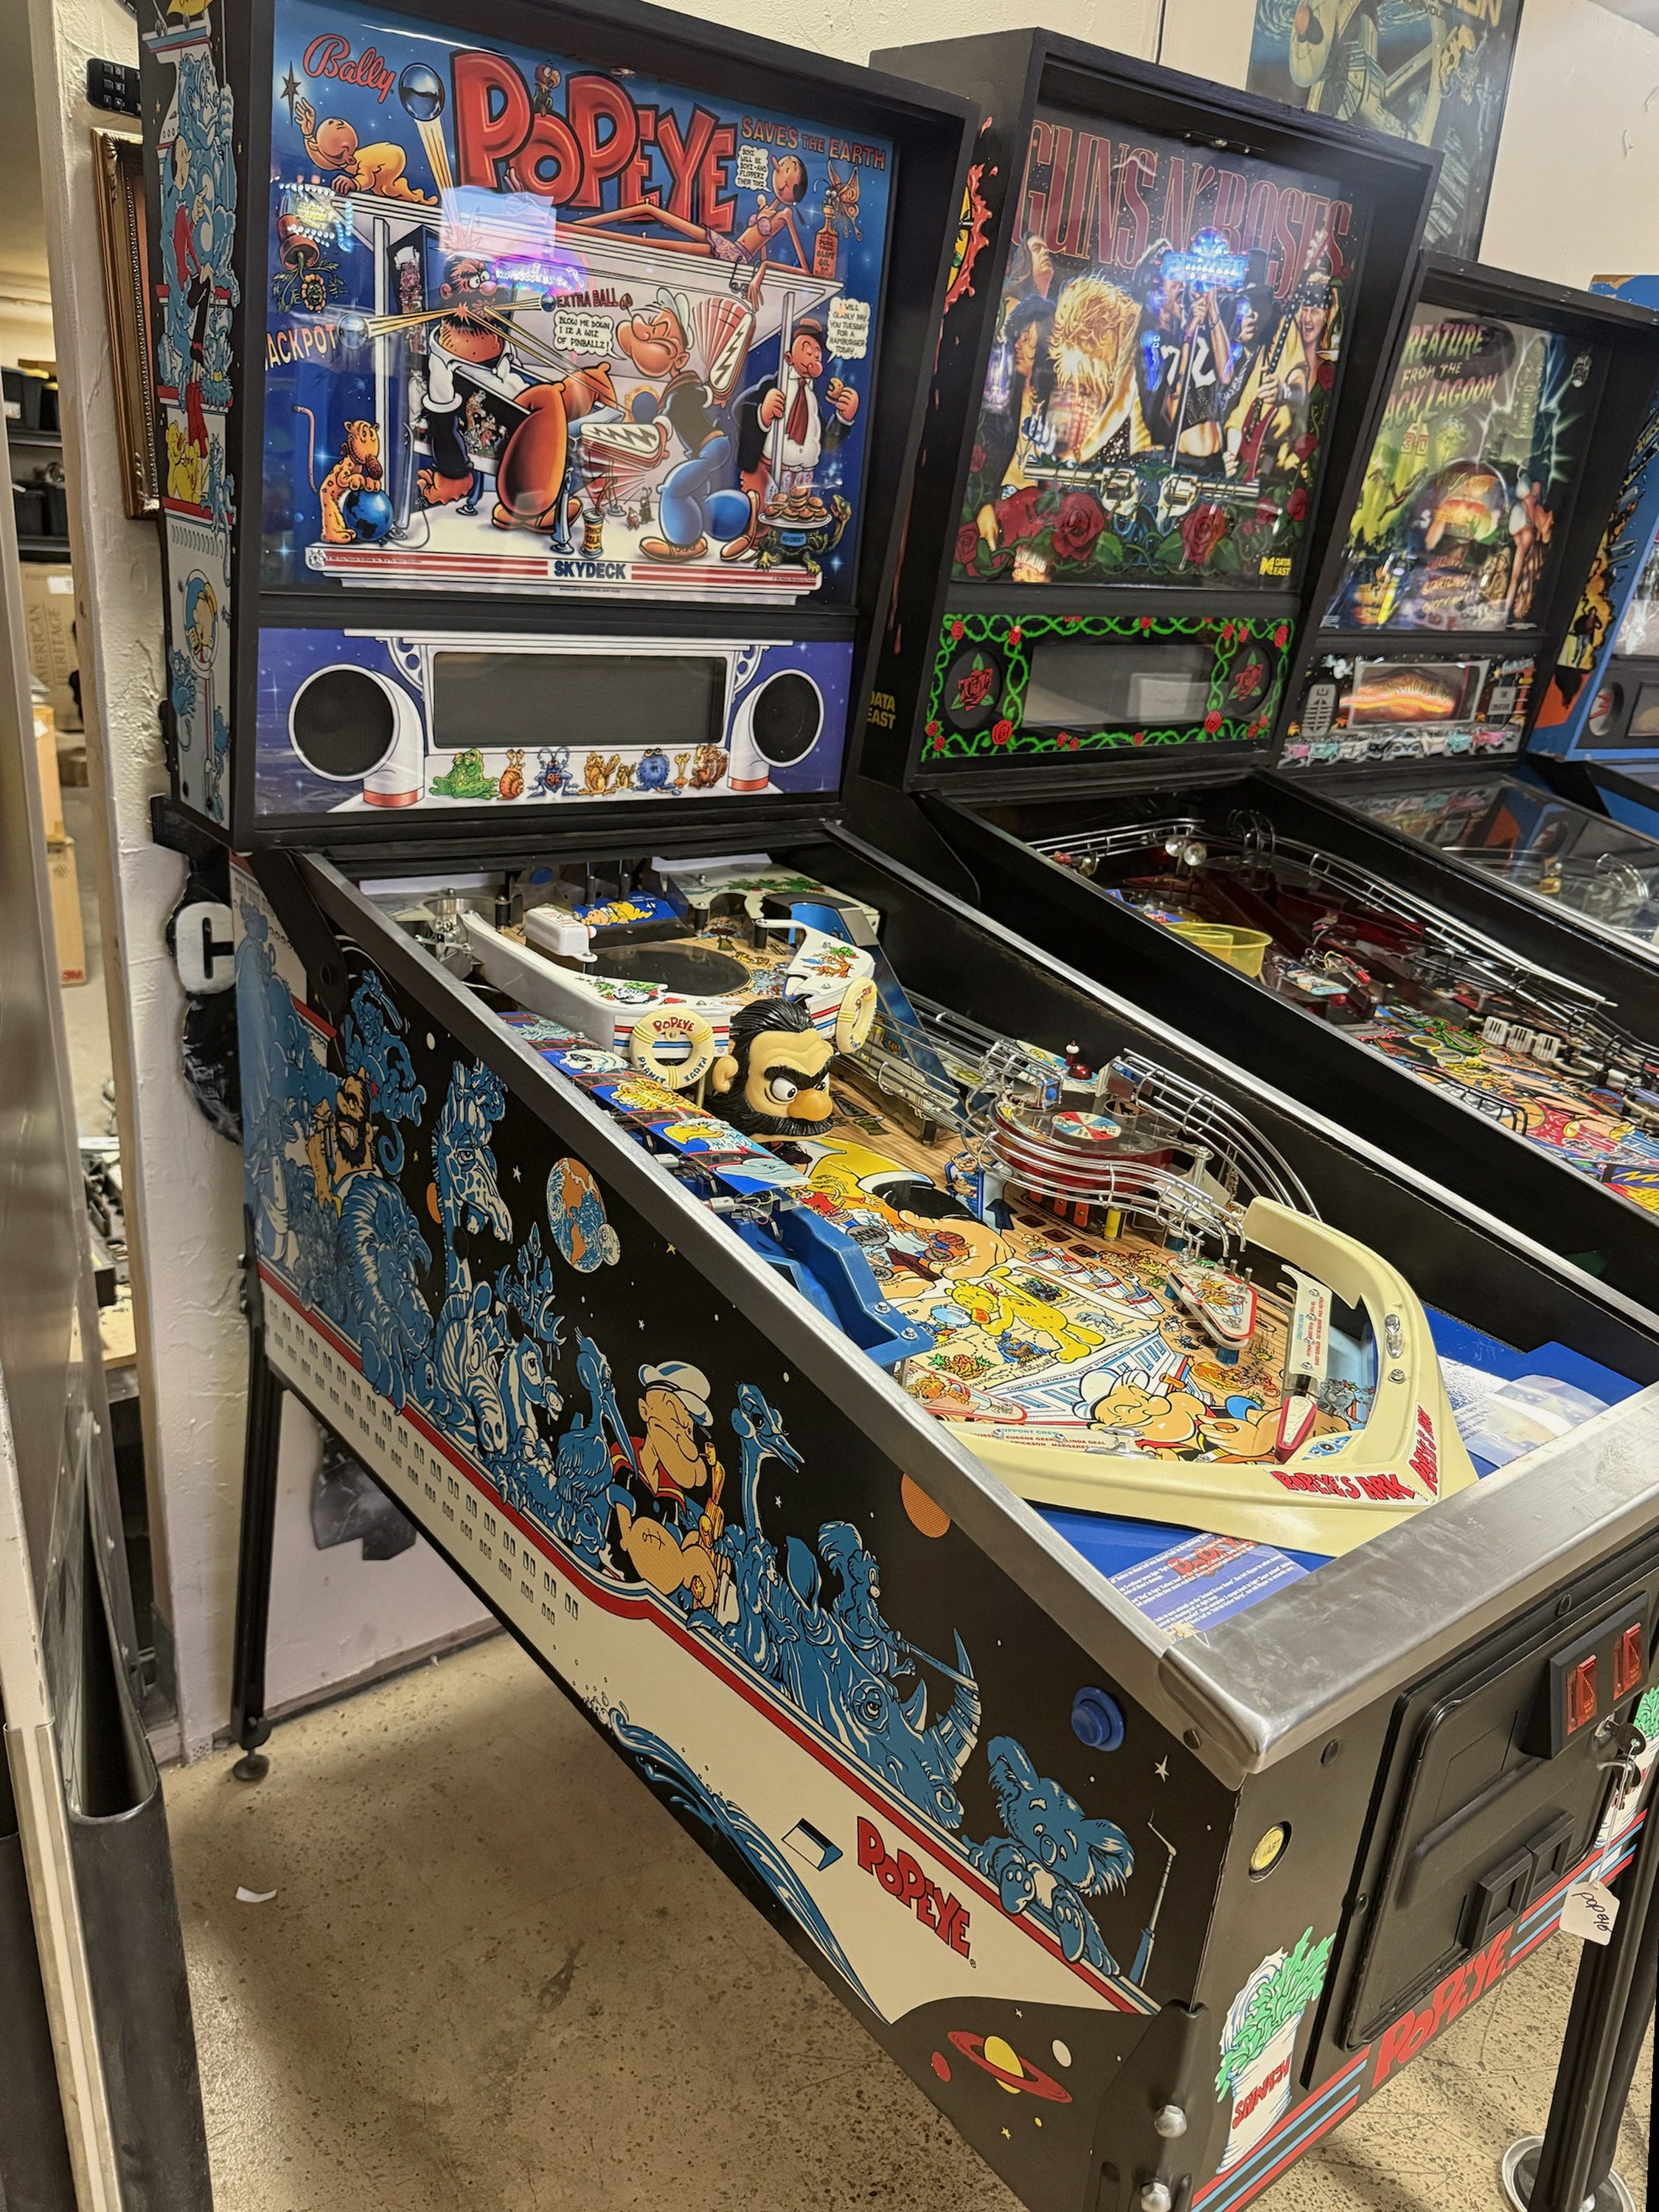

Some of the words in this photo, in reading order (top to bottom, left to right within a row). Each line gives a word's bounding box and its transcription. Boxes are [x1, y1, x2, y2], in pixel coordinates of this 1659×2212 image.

[303, 33, 397, 103] Bally
[448, 47, 738, 234] POPEYE
[740, 116, 799, 149] SAVES
[801, 134, 825, 153] THE
[827, 138, 886, 170] EARTH
[1012, 119, 1158, 270] GUNS
[1214, 169, 1354, 300] ROSES
[557, 291, 592, 307] EXTRA
[592, 288, 619, 307] BALL
[559, 316, 578, 325] BLOW
[580, 319, 590, 327] ME
[591, 321, 611, 330] DOWN
[559, 326, 563, 334] I
[576, 328, 582, 336] A
[584, 329, 599, 338] WIZ
[830, 320, 841, 329] YOU
[842, 321, 867, 332] TUESDAY
[1400, 364, 1436, 389] FROM
[1439, 361, 1463, 379] THE
[1422, 372, 1499, 422] LAGOON
[554, 560, 626, 580] SKYDECK
[1273, 566, 1290, 576] EAST
[1275, 557, 1290, 566] DATA
[63, 970, 83, 982] 3M
[652, 1016, 695, 1032] POPEYE
[637, 1056, 667, 1084] PLANET
[683, 1056, 708, 1082] EARTH
[850, 1227, 876, 1238] SAVE
[854, 1231, 887, 1242] OLIVE
[1006, 1381, 1040, 1391] COMPLETE
[1002, 1427, 1034, 1436] UPPORT
[1417, 1404, 1435, 1441] ARK
[1270, 1470, 1361, 1500] POPEYE'S
[1354, 1473, 1416, 1500] ARK
[857, 1815, 970, 1960] POPEYE
[1371, 1927, 1513, 2091] POPEYE
[1232, 2054, 1291, 2129] SPINACH
